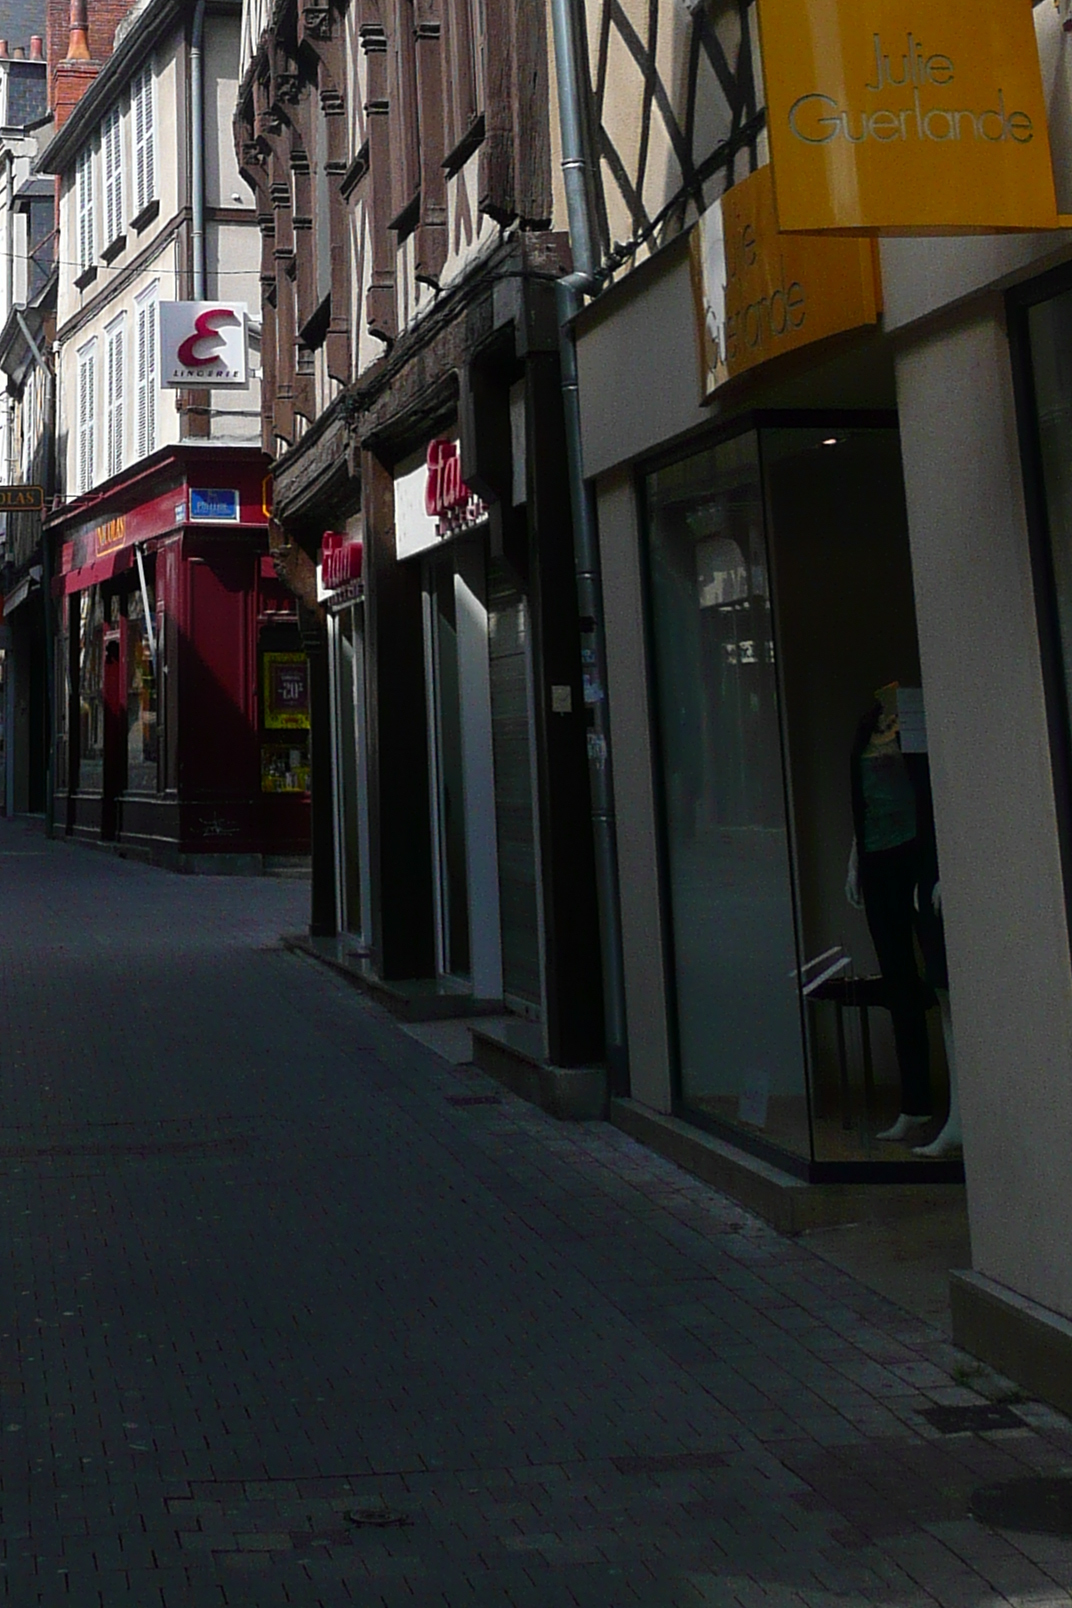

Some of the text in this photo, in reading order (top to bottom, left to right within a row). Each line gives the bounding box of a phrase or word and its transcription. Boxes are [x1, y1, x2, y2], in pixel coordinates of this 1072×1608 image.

[866, 32, 955, 93] Julie
[788, 88, 1034, 145] Guerlande
[706, 253, 807, 373] Guerande
[173, 369, 240, 378] LINGERIE
